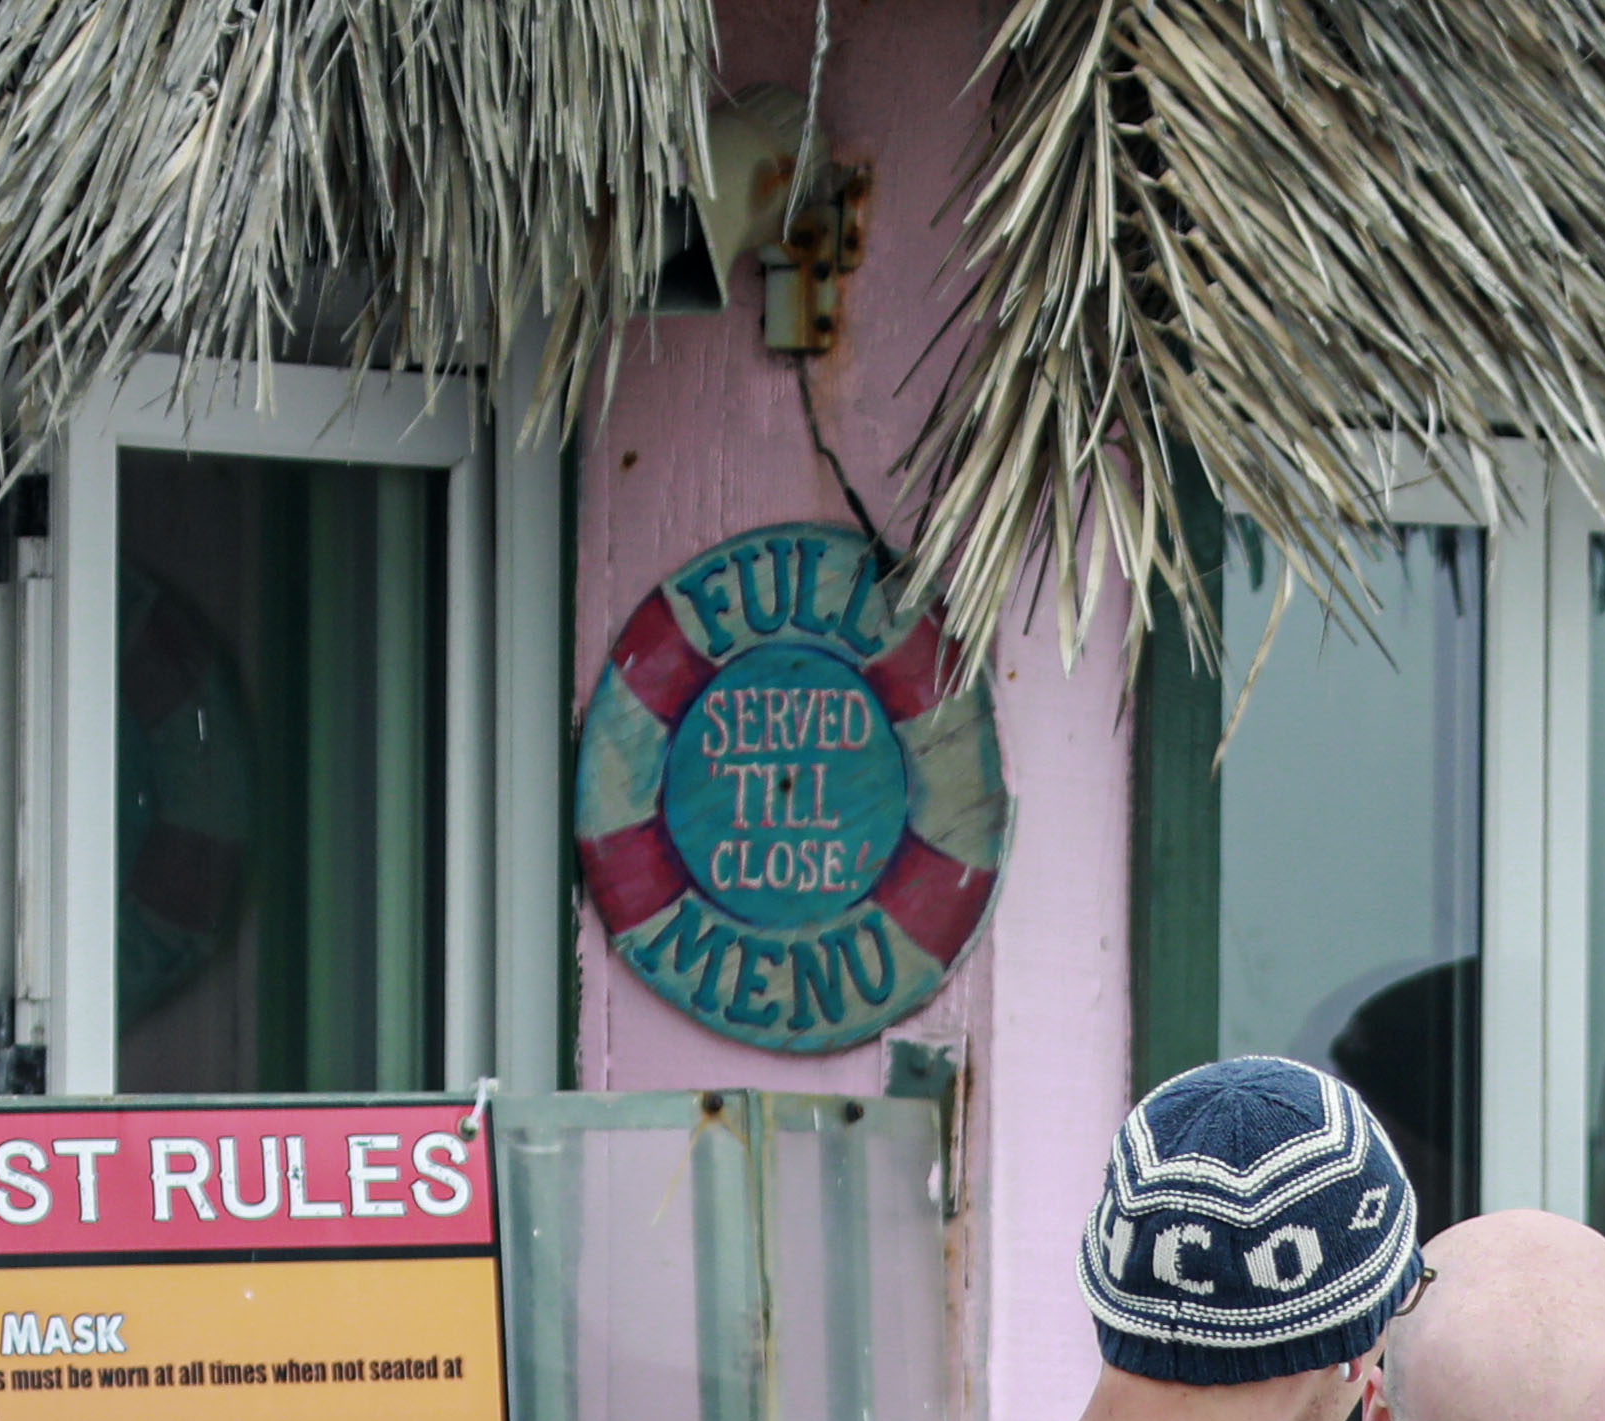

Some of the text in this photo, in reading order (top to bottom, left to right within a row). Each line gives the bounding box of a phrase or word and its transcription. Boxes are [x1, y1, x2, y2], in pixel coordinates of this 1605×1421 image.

[676, 537, 886, 660] FULL
[702, 687, 873, 758] SERVED
[709, 762, 841, 830] 'TILL
[710, 840, 870, 893] CLOSE!
[632, 899, 895, 1032] MENU
[148, 1128, 472, 1224] RULES
[11, 1364, 62, 1390] must
[68, 1364, 92, 1388] be
[99, 1366, 149, 1388] worn
[154, 1363, 173, 1386] at
[180, 1361, 204, 1385] all
[210, 1360, 267, 1384] times
[273, 1358, 326, 1383] when
[332, 1358, 364, 1383] not
[370, 1356, 438, 1381] seated
[444, 1357, 462, 1379] at
